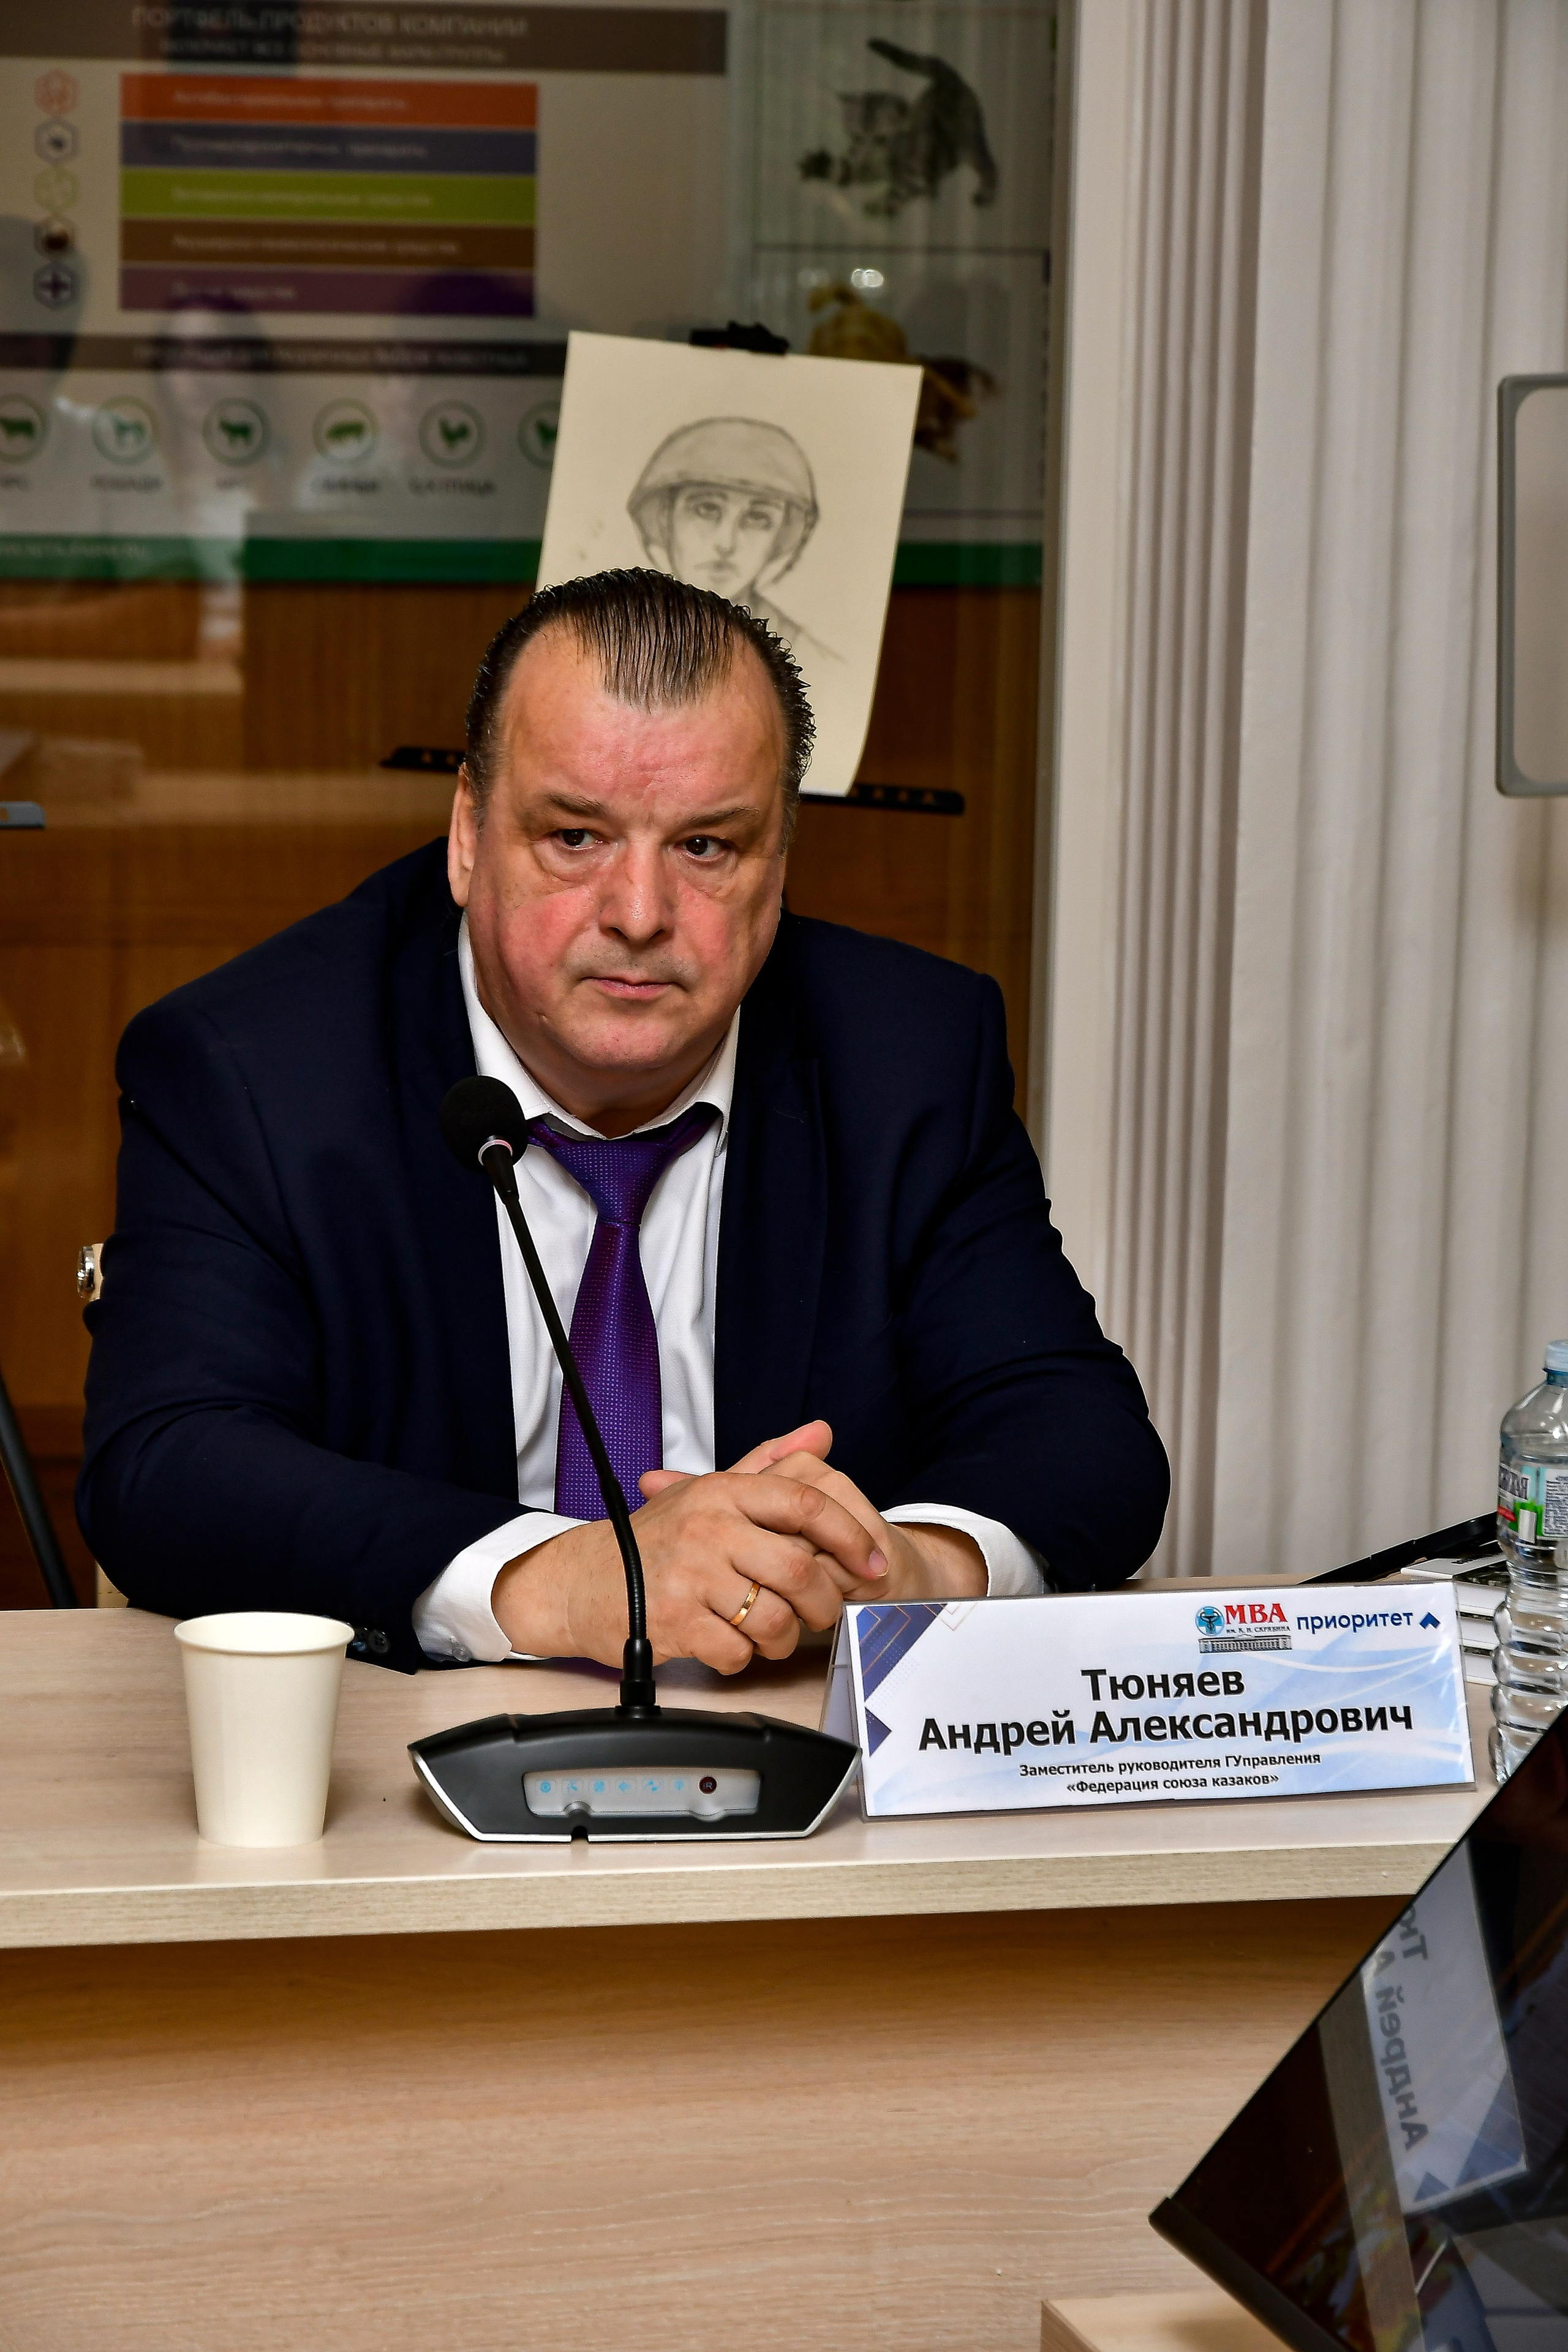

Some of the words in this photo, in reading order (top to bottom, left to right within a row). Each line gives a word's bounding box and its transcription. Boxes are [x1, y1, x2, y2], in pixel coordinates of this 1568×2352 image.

[1225, 1603, 1288, 1624] МВА
[1297, 1612, 1414, 1634] приоритет
[1080, 1668, 1245, 1702] Тюняев
[918, 1709, 1076, 1756] Андрей
[1090, 1705, 1413, 1743] Александрович
[1019, 1763, 1114, 1776] Заместитель
[1118, 1758, 1221, 1776] руководителя
[1225, 1754, 1321, 1770] ГУправления
[1066, 1780, 1159, 1795] «Федерация
[1163, 1778, 1207, 1789] союза
[1212, 1775, 1279, 1787] казаков»
